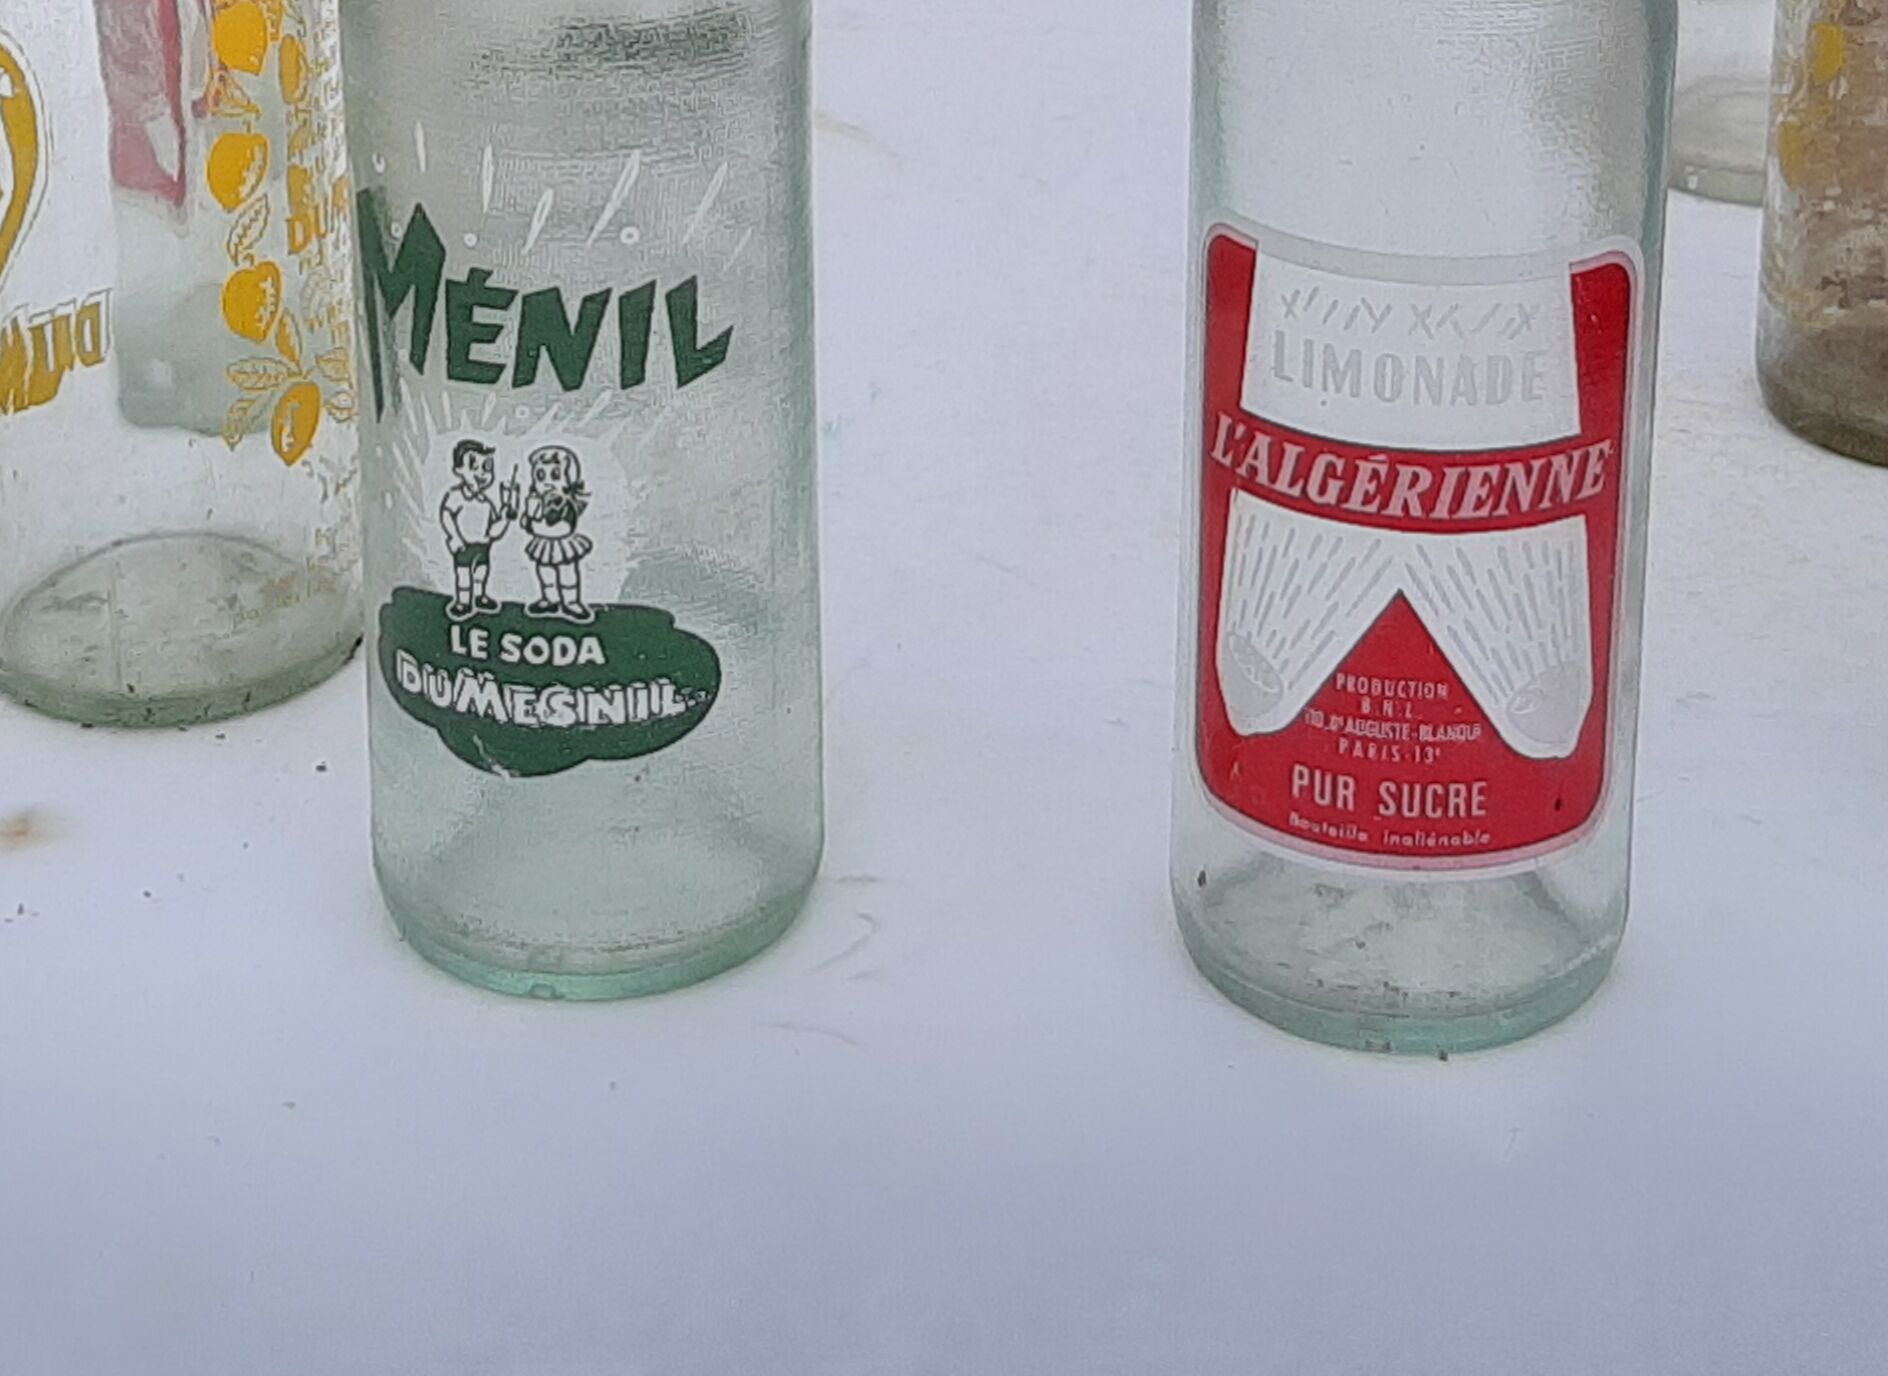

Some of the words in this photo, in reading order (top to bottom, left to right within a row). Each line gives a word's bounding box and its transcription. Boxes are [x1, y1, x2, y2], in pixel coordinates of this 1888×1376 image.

[357, 186, 734, 423] MÉNIL
[1270, 329, 1544, 407] LIMONADE
[1211, 412, 1612, 521] L'ALGÉRIENNE
[450, 625, 489, 660] LE
[500, 633, 606, 666] SODA
[1336, 672, 1449, 700] PRODUCTION
[1291, 763, 1356, 812] PUR
[1378, 781, 1488, 819] SUCRE
